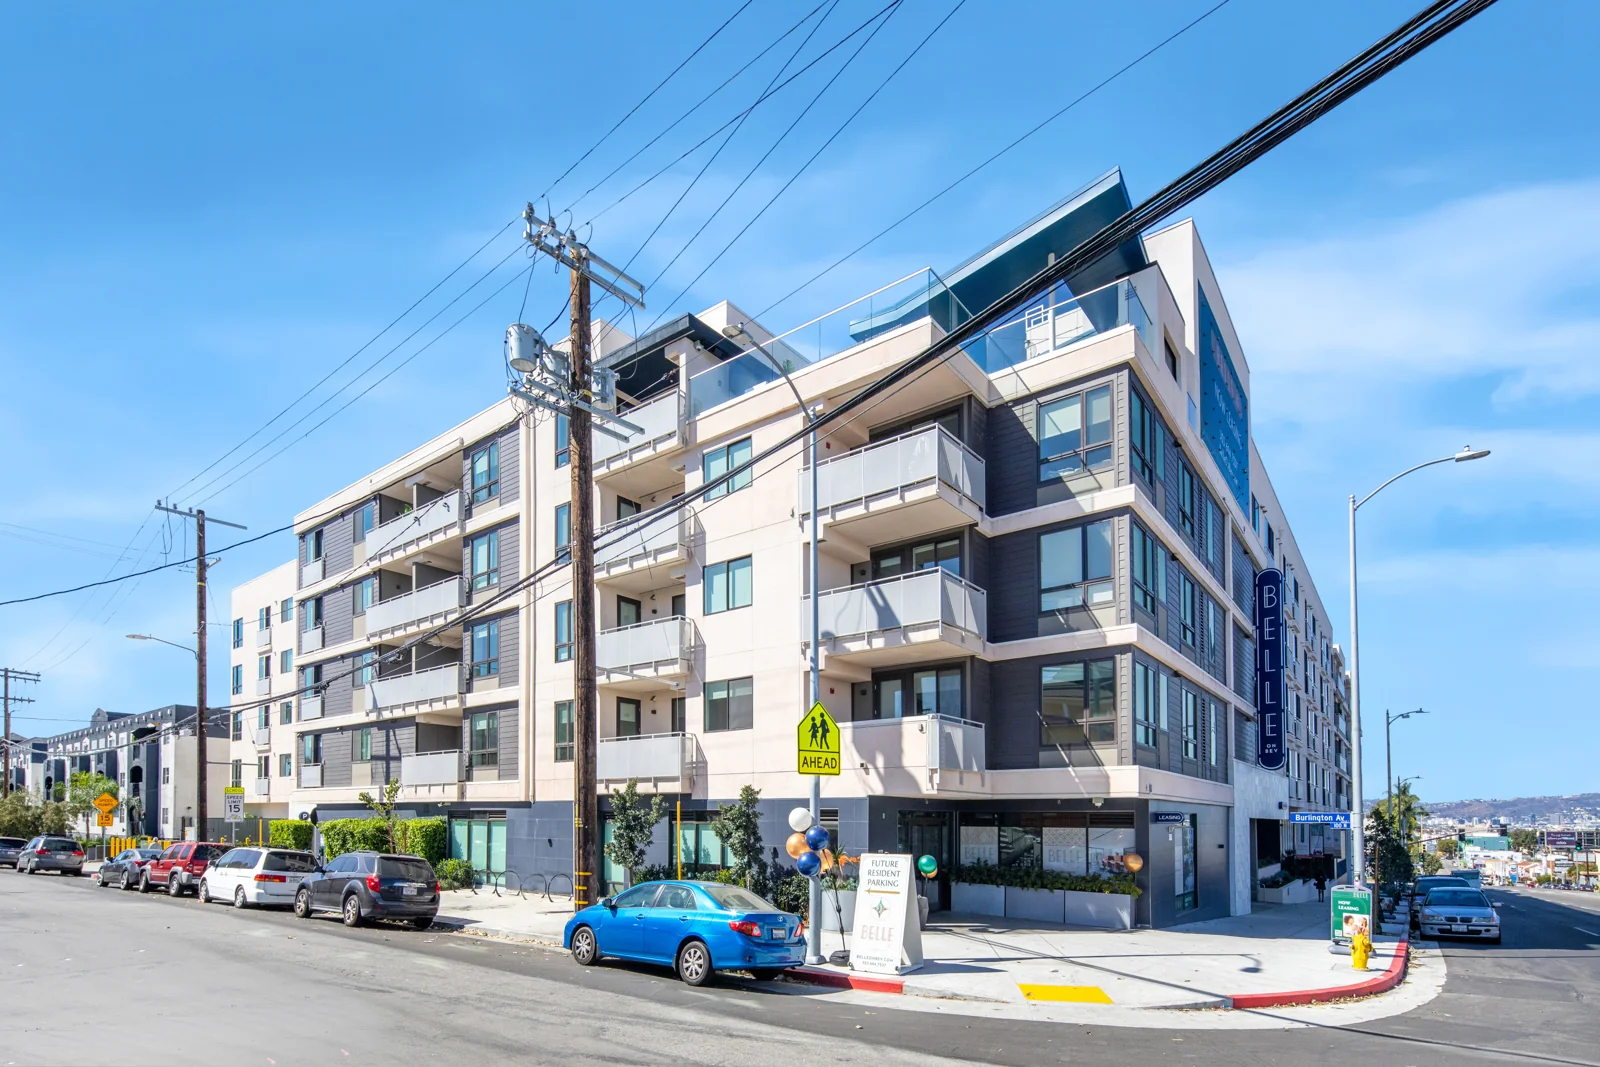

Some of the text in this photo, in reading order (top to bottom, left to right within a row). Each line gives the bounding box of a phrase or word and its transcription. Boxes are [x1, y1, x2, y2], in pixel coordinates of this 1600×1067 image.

[1263, 585, 1278, 737] BELLE
[801, 755, 838, 769] AHEAD
[228, 804, 241, 813] 15
[100, 814, 111, 822] 15
[1295, 814, 1333, 823] Burlington
[964, 846, 995, 861] BELLE
[1048, 849, 1083, 864] BELLE
[871, 859, 899, 868] FUTURE
[867, 869, 901, 878] RESIDENT
[867, 879, 899, 888] PARKING
[860, 924, 895, 942] BELLE
